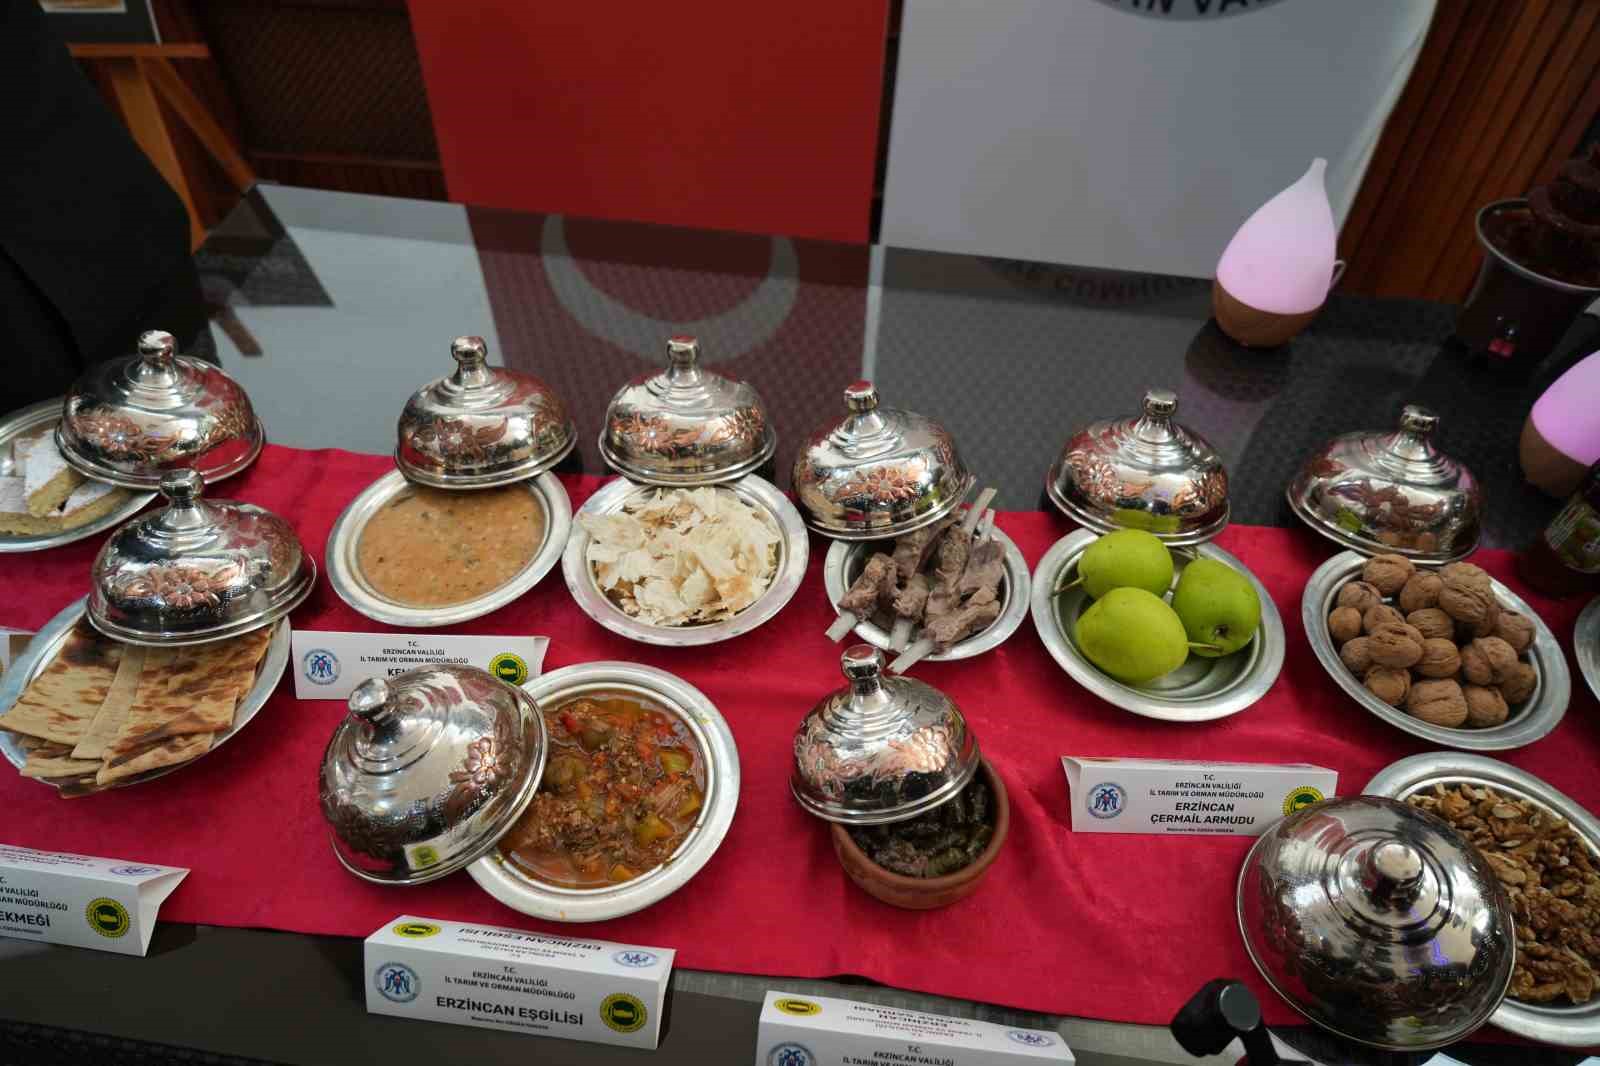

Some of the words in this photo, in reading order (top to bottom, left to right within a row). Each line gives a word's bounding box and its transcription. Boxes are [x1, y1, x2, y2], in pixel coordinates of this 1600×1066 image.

[1212, 782, 1241, 790] VALİLİĞİ
[1219, 790, 1264, 799] MÜDÜRLÜĞÜ
[1175, 801, 1234, 812] ERZİNCAN
[1151, 813, 1202, 825] ÇERMAİL
[1204, 815, 1255, 825] ARMUDU
[504, 966, 517, 974] T.C.
[472, 970, 513, 983] ERZİNCAN
[515, 976, 548, 987] VALİLİĞİ
[454, 977, 478, 987] TARIM
[491, 982, 521, 992] ORMAN
[523, 986, 576, 1000] MÜDÜRLÜĞÜ
[436, 996, 514, 1016] ERZİNCAN
[519, 1007, 583, 1026] EŞGİLİSİ
[907, 1045, 922, 1054] T.C.
[873, 1050, 917, 1062] ERZİNCAN
